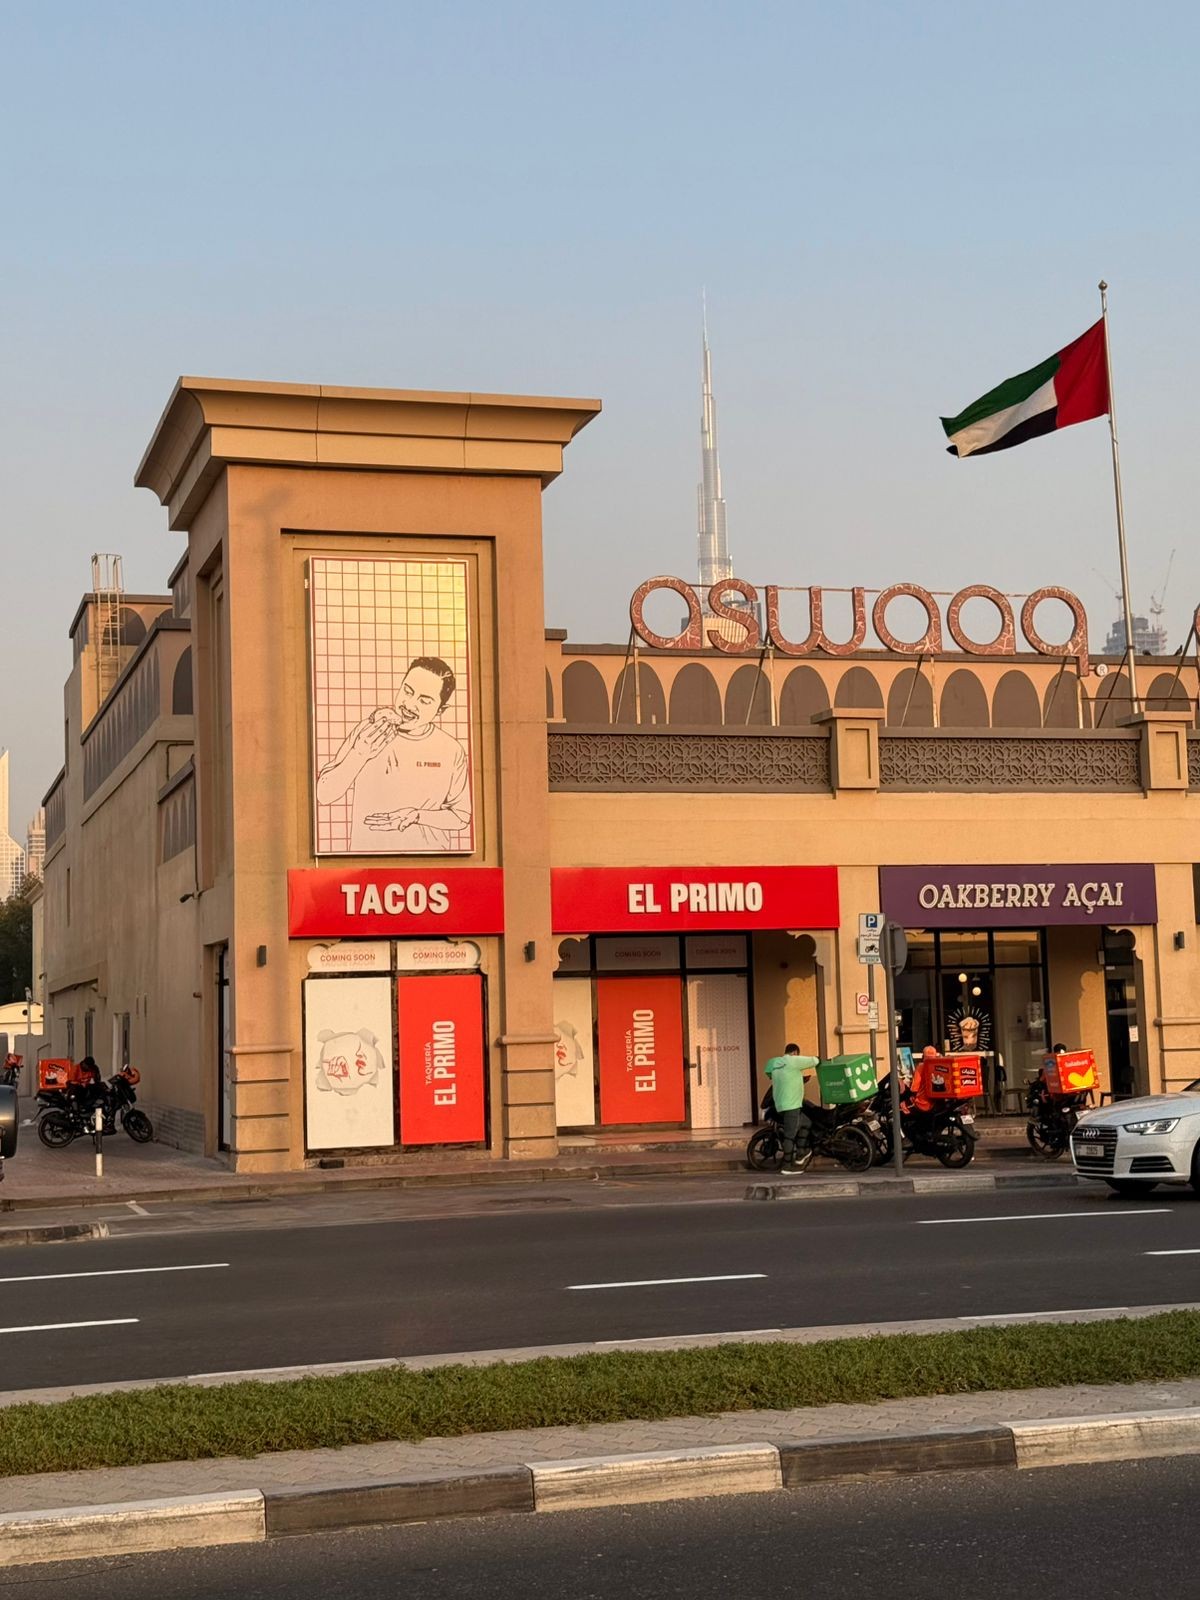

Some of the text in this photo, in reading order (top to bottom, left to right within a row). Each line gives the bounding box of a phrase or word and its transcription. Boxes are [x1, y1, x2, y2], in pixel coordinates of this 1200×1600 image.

[630, 575, 1089, 677] aswaaq
[341, 883, 449, 915] TACOS
[628, 882, 763, 913] EL PRIMO
[919, 882, 1124, 914] OAKBERRY AÇAI
[320, 953, 376, 962] COMING SOON
[412, 951, 467, 960] COMING SOON
[614, 950, 662, 959] COMING SOON
[424, 1042, 433, 1086] TAQUERÍA
[433, 1020, 456, 1105] EL PRIMO
[624, 1030, 633, 1072] TAQUERÍA
[633, 1009, 656, 1092] EL PRIMO
